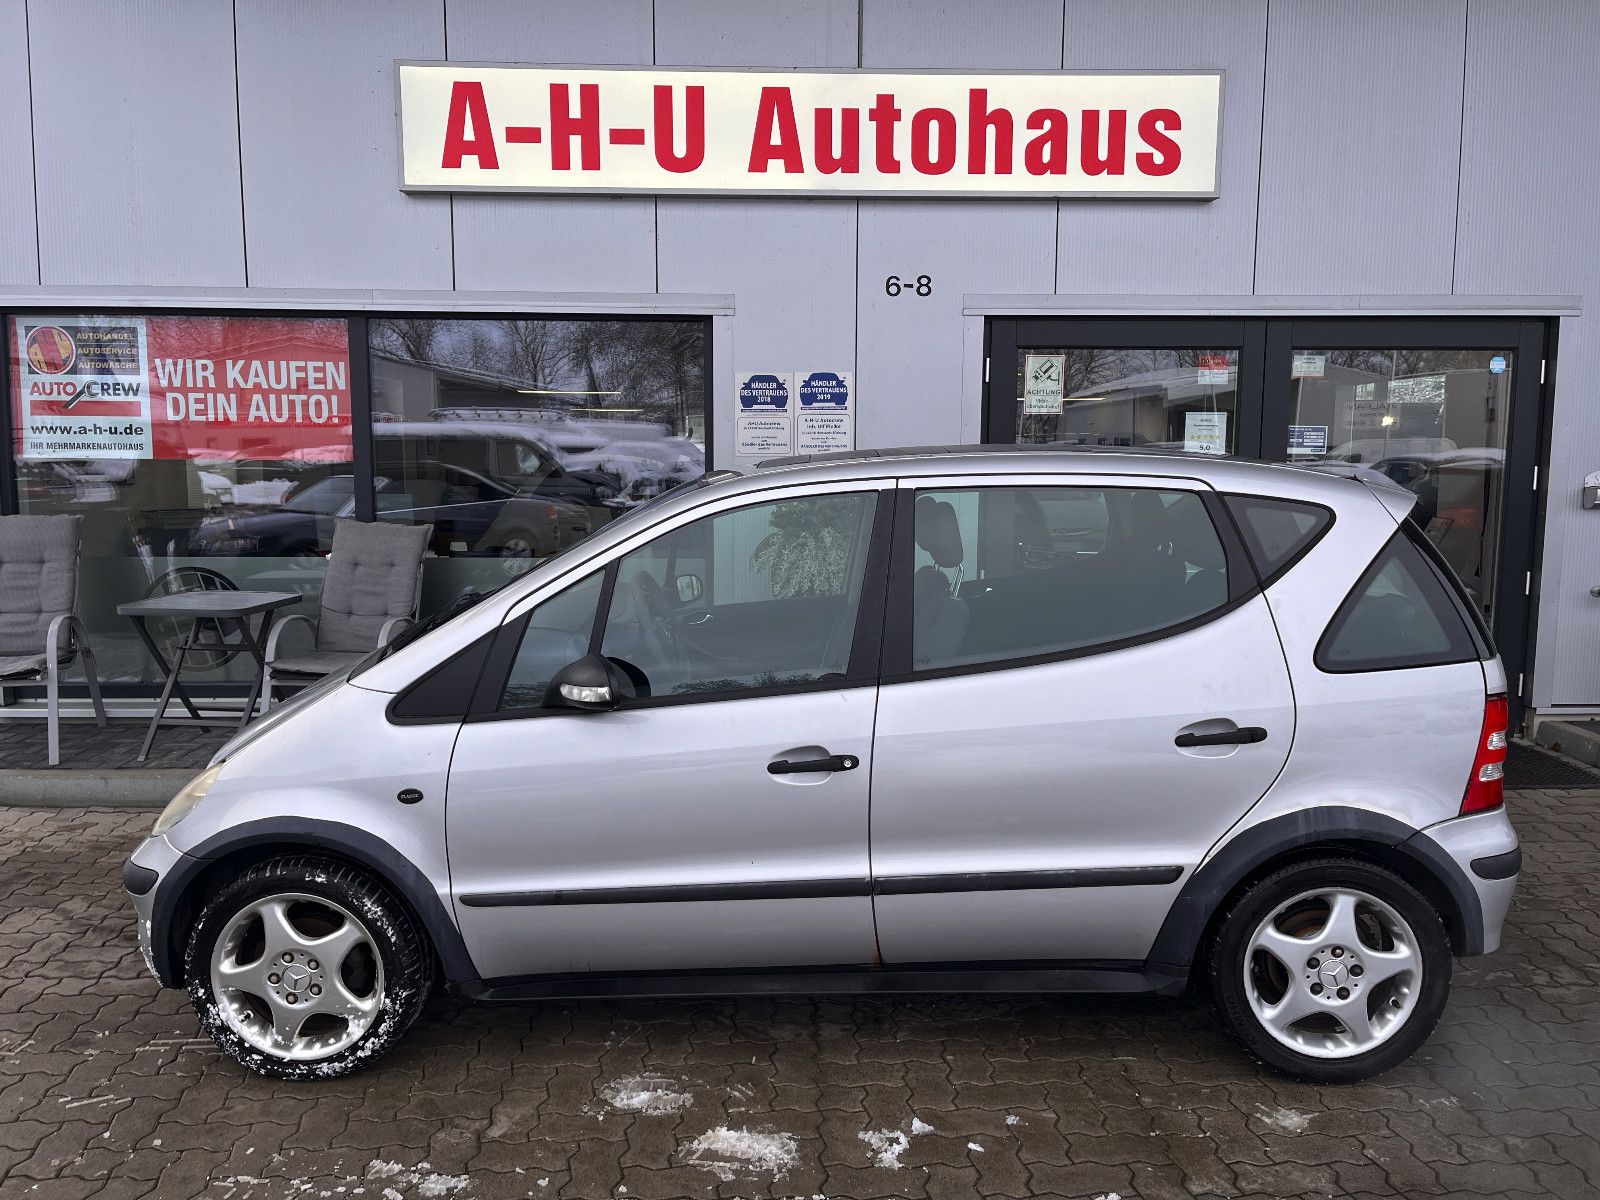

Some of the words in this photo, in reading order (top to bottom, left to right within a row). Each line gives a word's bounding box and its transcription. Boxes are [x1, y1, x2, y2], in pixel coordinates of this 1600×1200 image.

[441, 80, 706, 174] A-H-U
[748, 85, 1182, 177] Autohaus
[885, 274, 932, 297] 6-8
[76, 332, 135, 340] AUTOHANDEL
[77, 347, 138, 355] AUTOSERVICE
[154, 358, 216, 388] WIR
[225, 359, 346, 390] KAUFEN
[752, 389, 788, 397] VERTRAUENS
[165, 392, 238, 422] DEIN
[248, 394, 339, 424] AUTO!
[31, 424, 144, 436] www.a-h-u.de
[30, 441, 44, 450] IHR
[46, 442, 144, 451] MEHRMARKENAUTOHAUS
